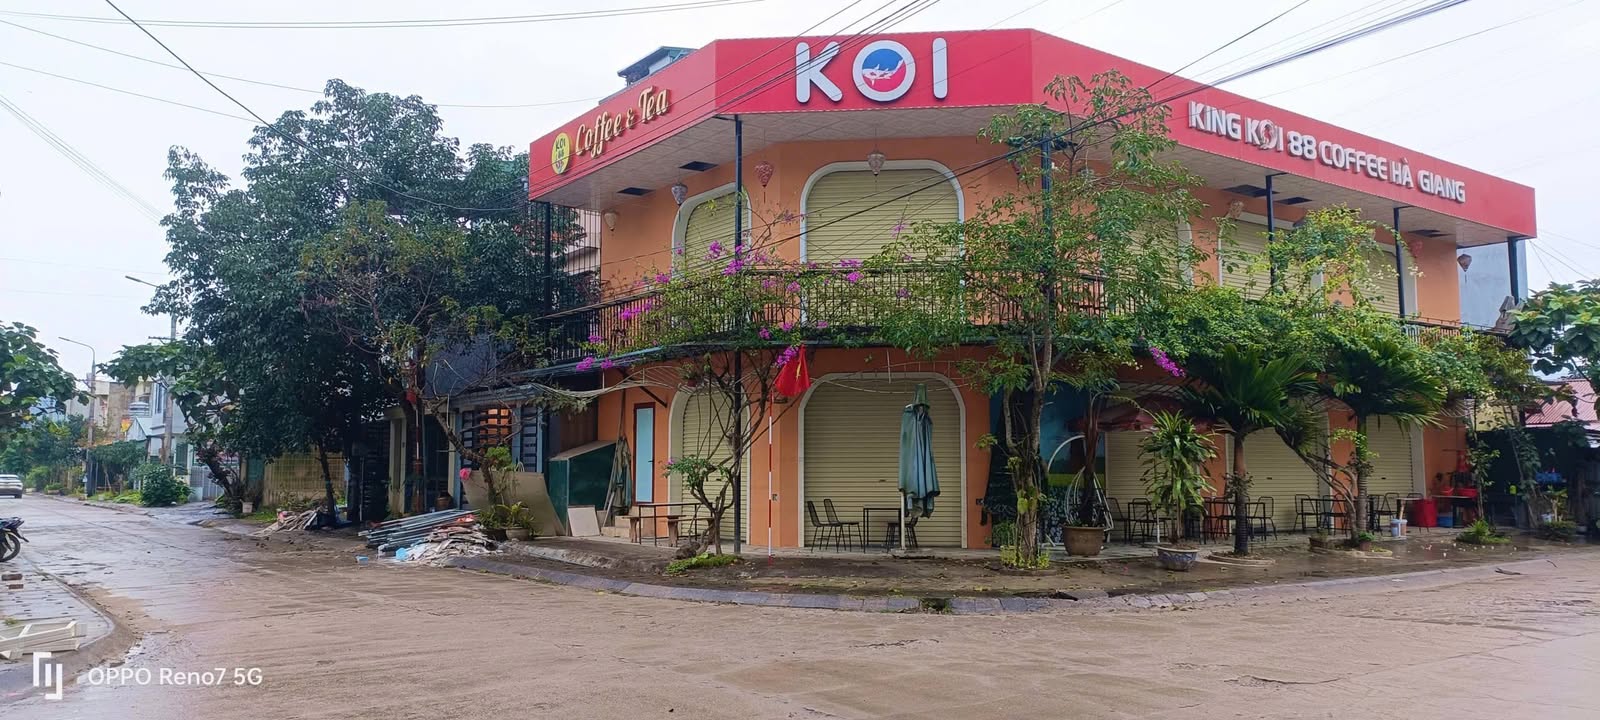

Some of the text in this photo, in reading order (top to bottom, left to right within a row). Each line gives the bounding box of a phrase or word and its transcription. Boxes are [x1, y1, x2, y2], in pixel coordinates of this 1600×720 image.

[795, 37, 948, 103] KOI
[575, 85, 669, 159] Coffee & Tea
[1188, 100, 1466, 203] KING KOI 88 COFFEE HÀ GIANG
